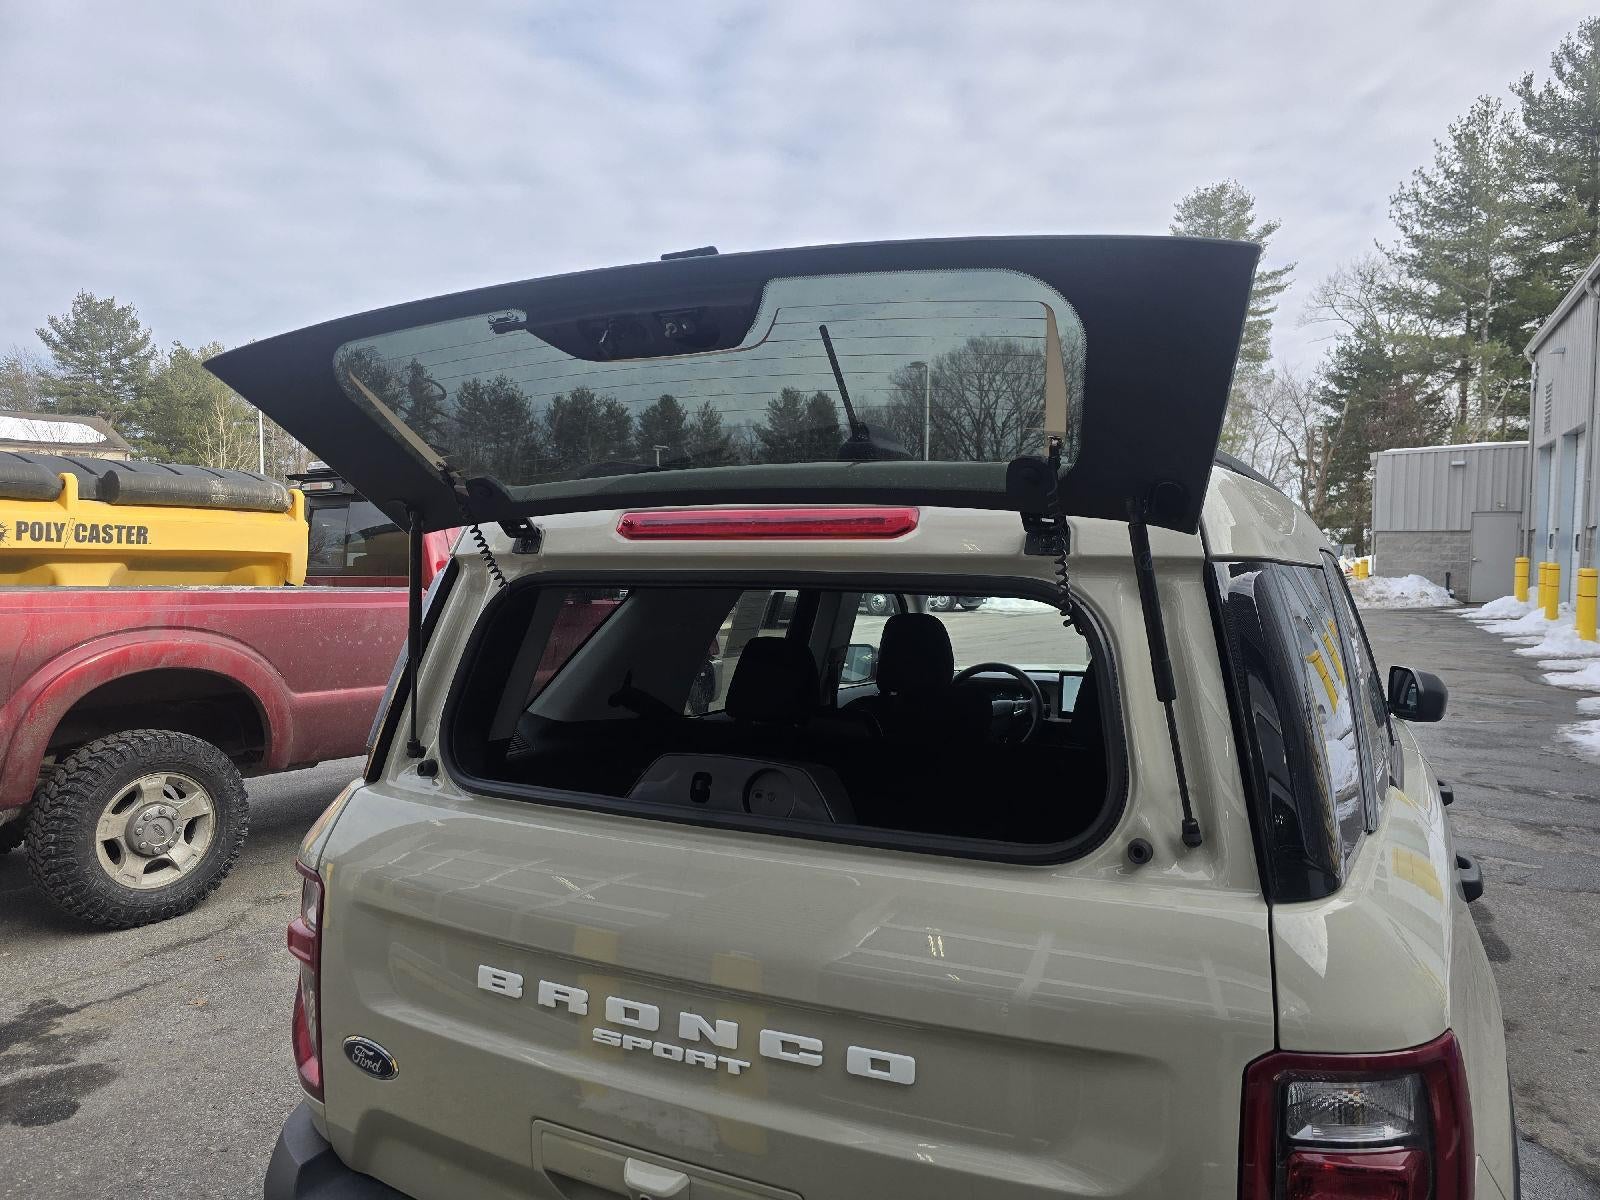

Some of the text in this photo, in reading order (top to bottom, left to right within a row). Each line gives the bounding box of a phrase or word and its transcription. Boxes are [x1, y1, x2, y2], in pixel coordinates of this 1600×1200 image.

[15, 520, 149, 545] POLY CASTER
[477, 964, 916, 1085] BRONCO
[352, 1045, 382, 1073] Ford
[592, 1027, 751, 1075] SPORT
